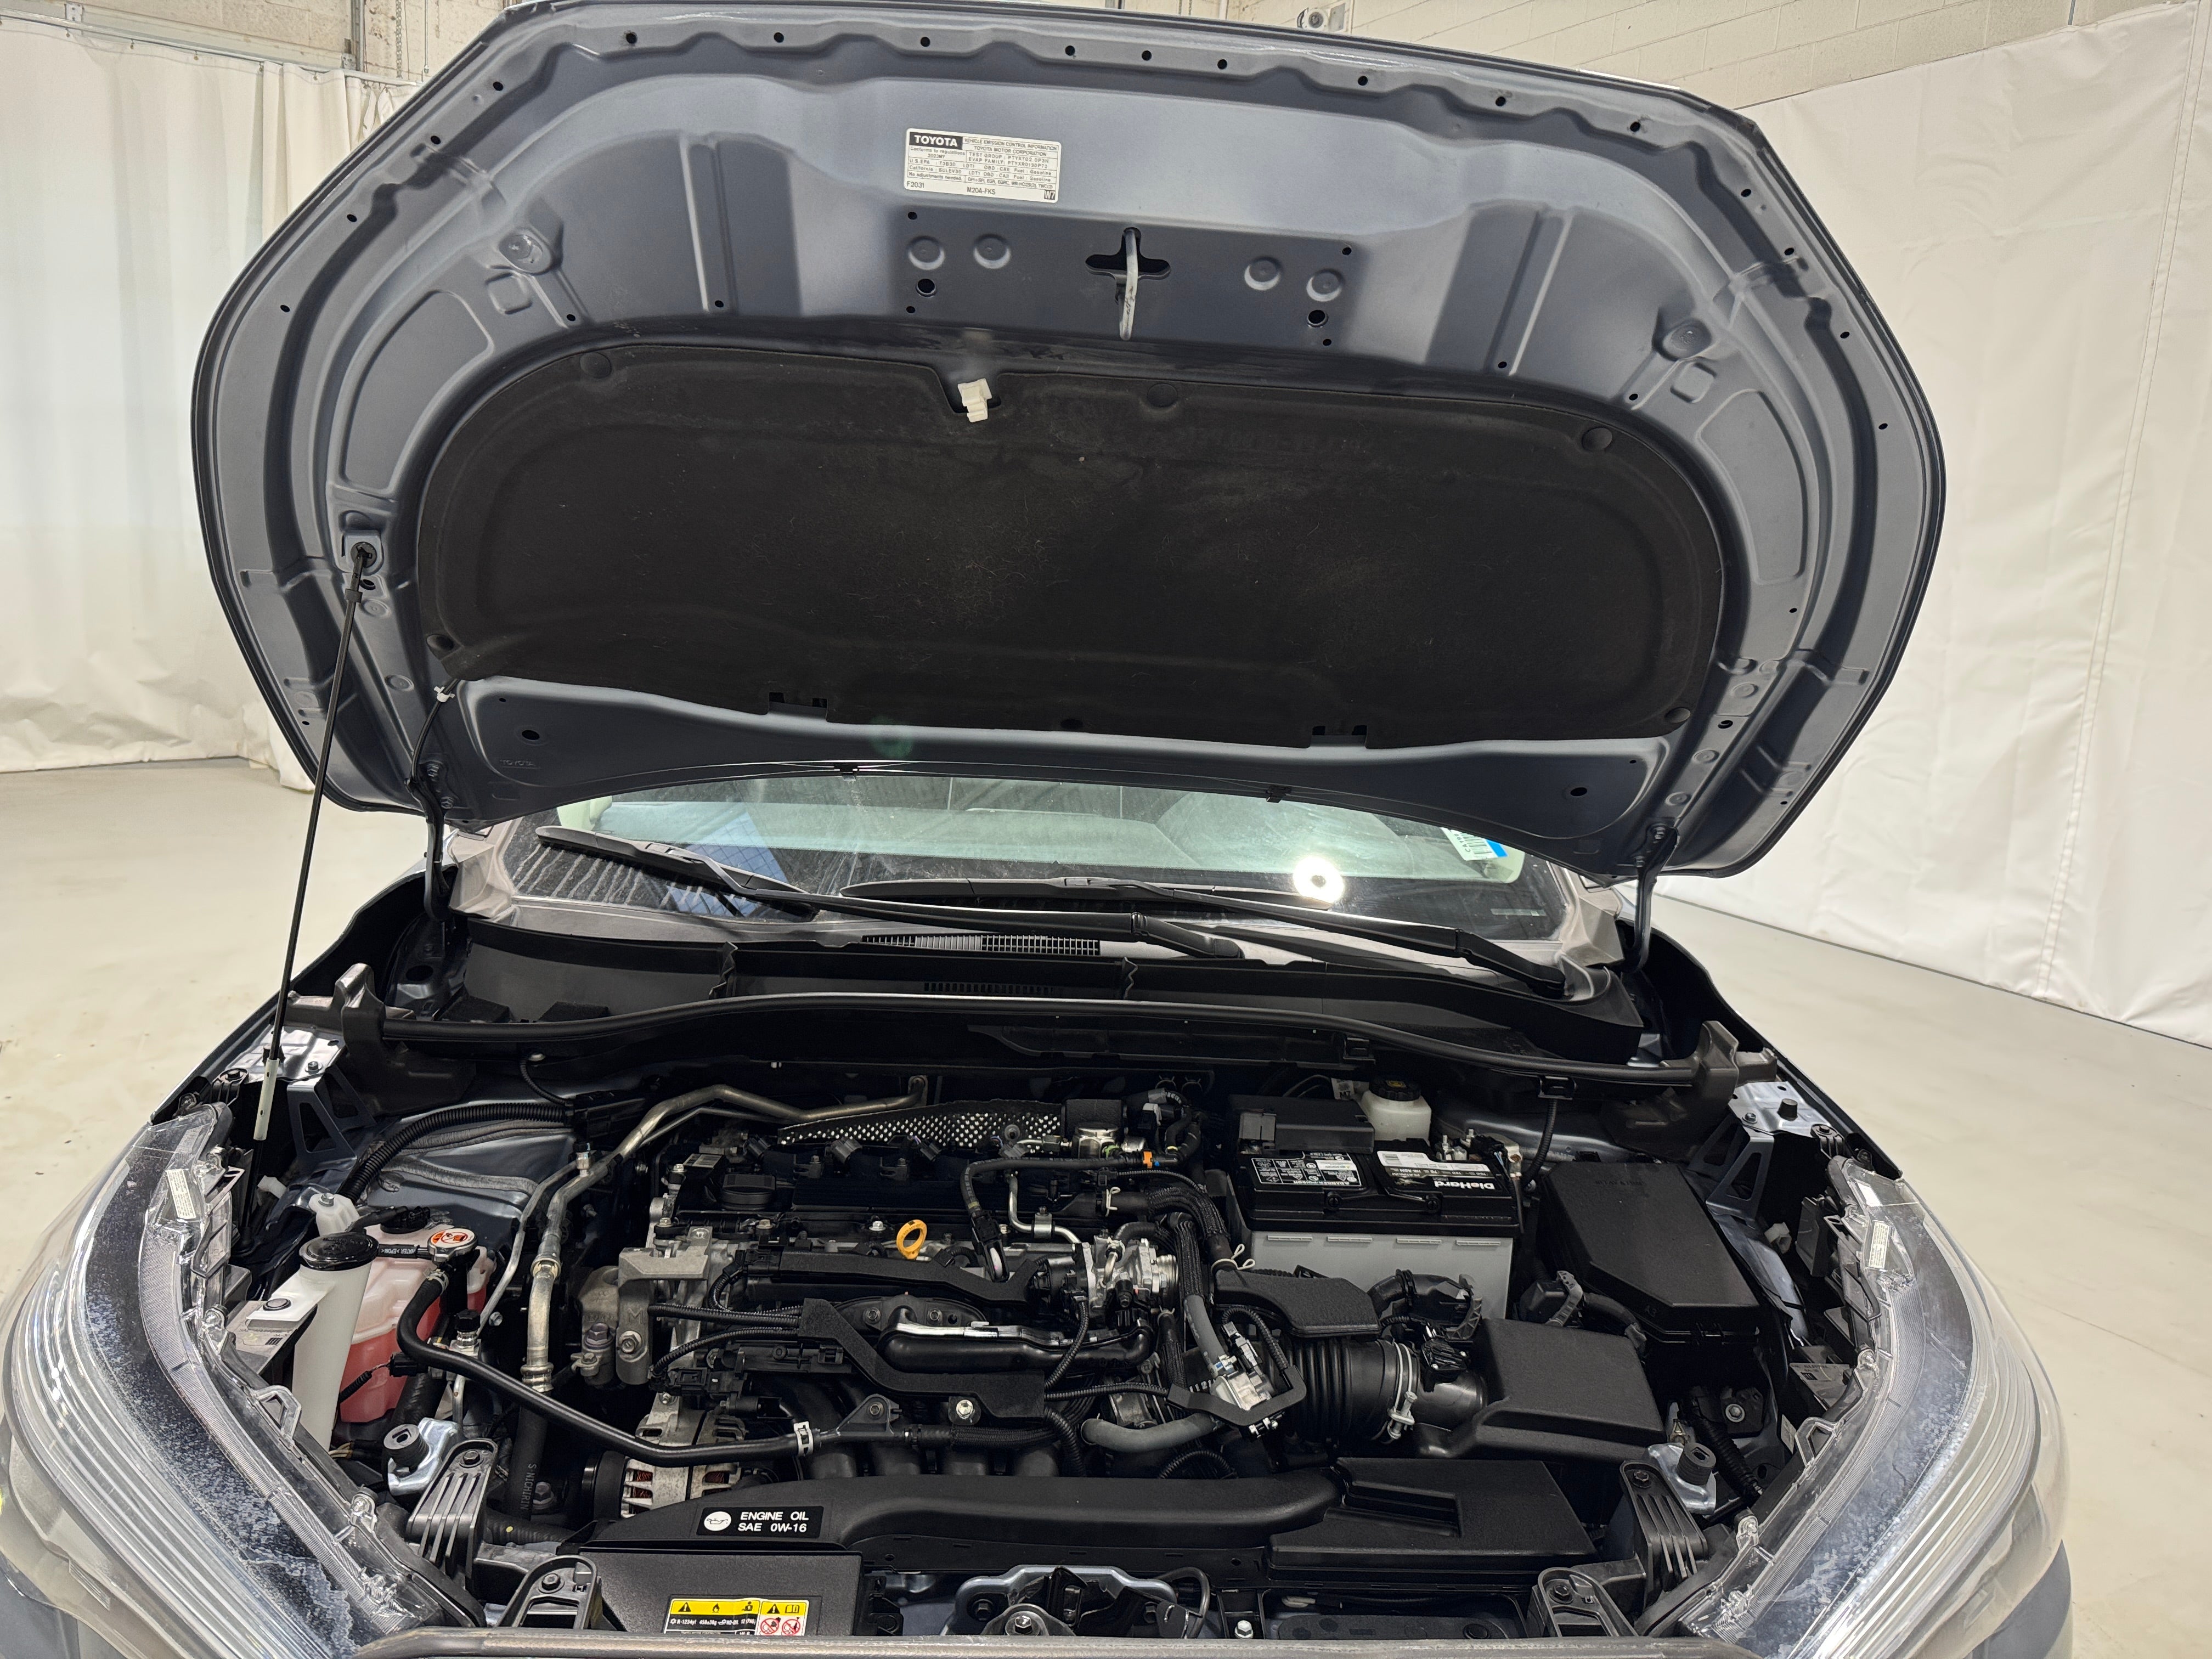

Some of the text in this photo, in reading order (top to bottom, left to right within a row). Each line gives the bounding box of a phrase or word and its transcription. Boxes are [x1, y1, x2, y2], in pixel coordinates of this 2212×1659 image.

[914, 134, 958, 147] TOYOTA
[907, 180, 924, 189] F2031
[967, 187, 996, 195] M20A-FKS
[1045, 190, 1056, 200] W7
[1434, 1181, 1496, 1190] DieHard
[740, 1511, 809, 1521] ENGINE OIL
[737, 1522, 807, 1532] SAE 0W-16
